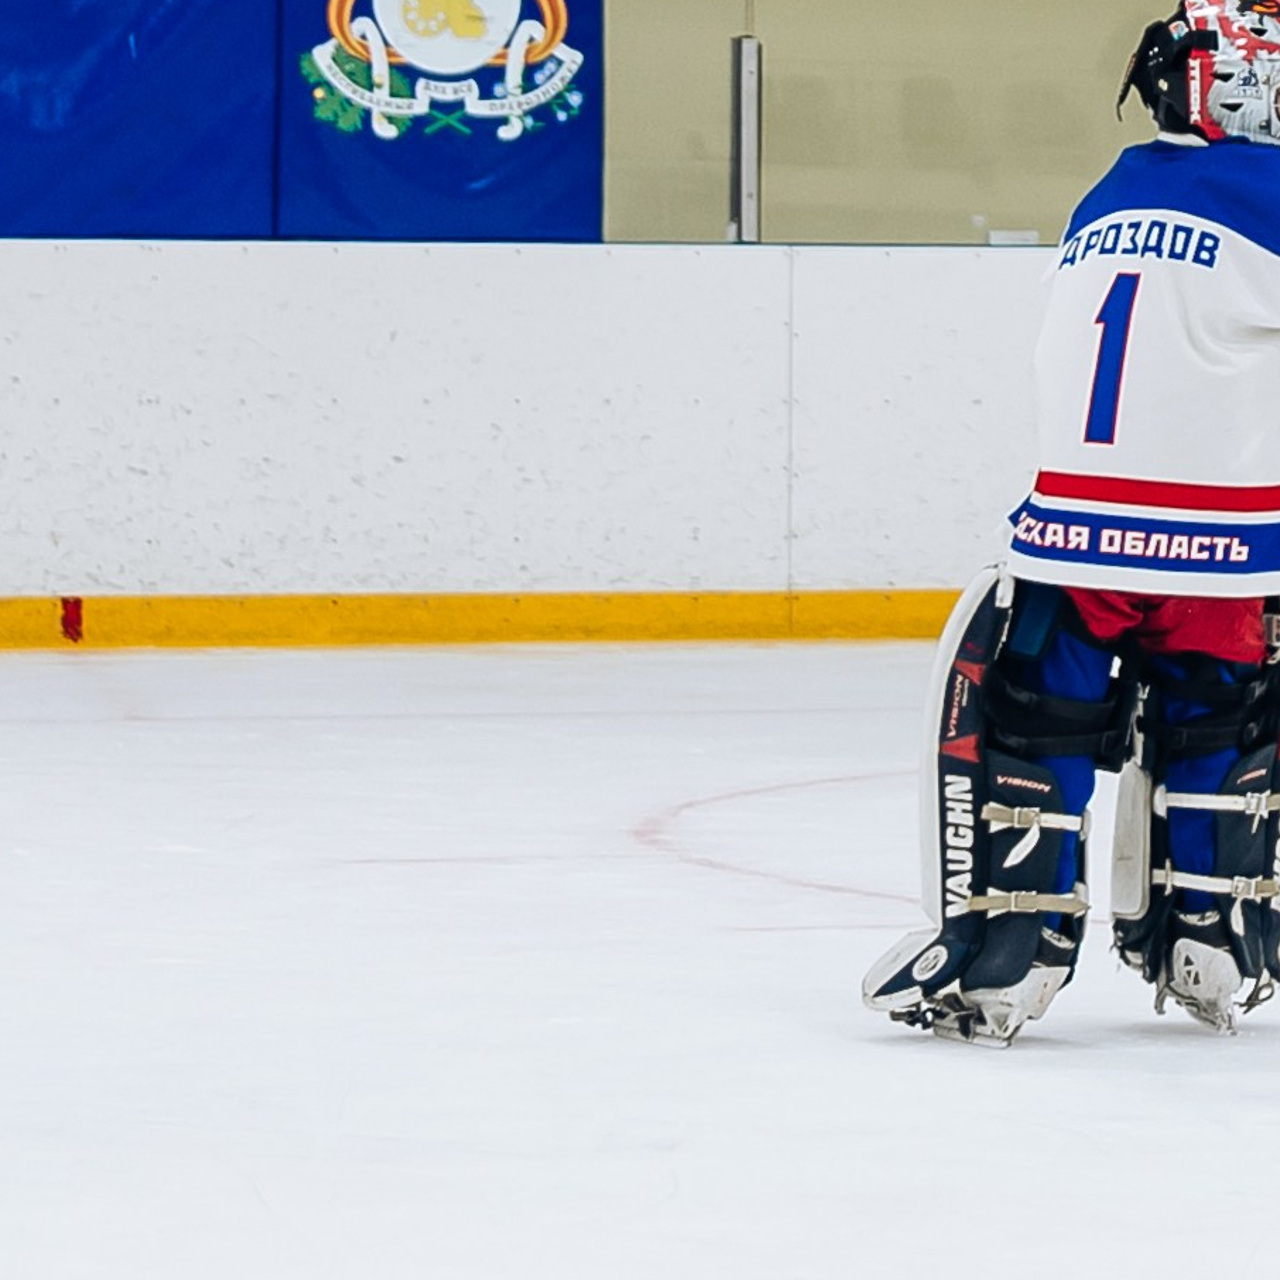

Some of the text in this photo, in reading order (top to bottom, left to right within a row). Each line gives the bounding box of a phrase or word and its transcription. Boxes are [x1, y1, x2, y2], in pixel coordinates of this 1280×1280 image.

[1058, 219, 1221, 270] ДРОЗДОВ
[1082, 271, 1142, 445] 1
[1015, 510, 1250, 562] СКАЯ ОБЛАСТЬ
[944, 773, 975, 919] VAUGHN
